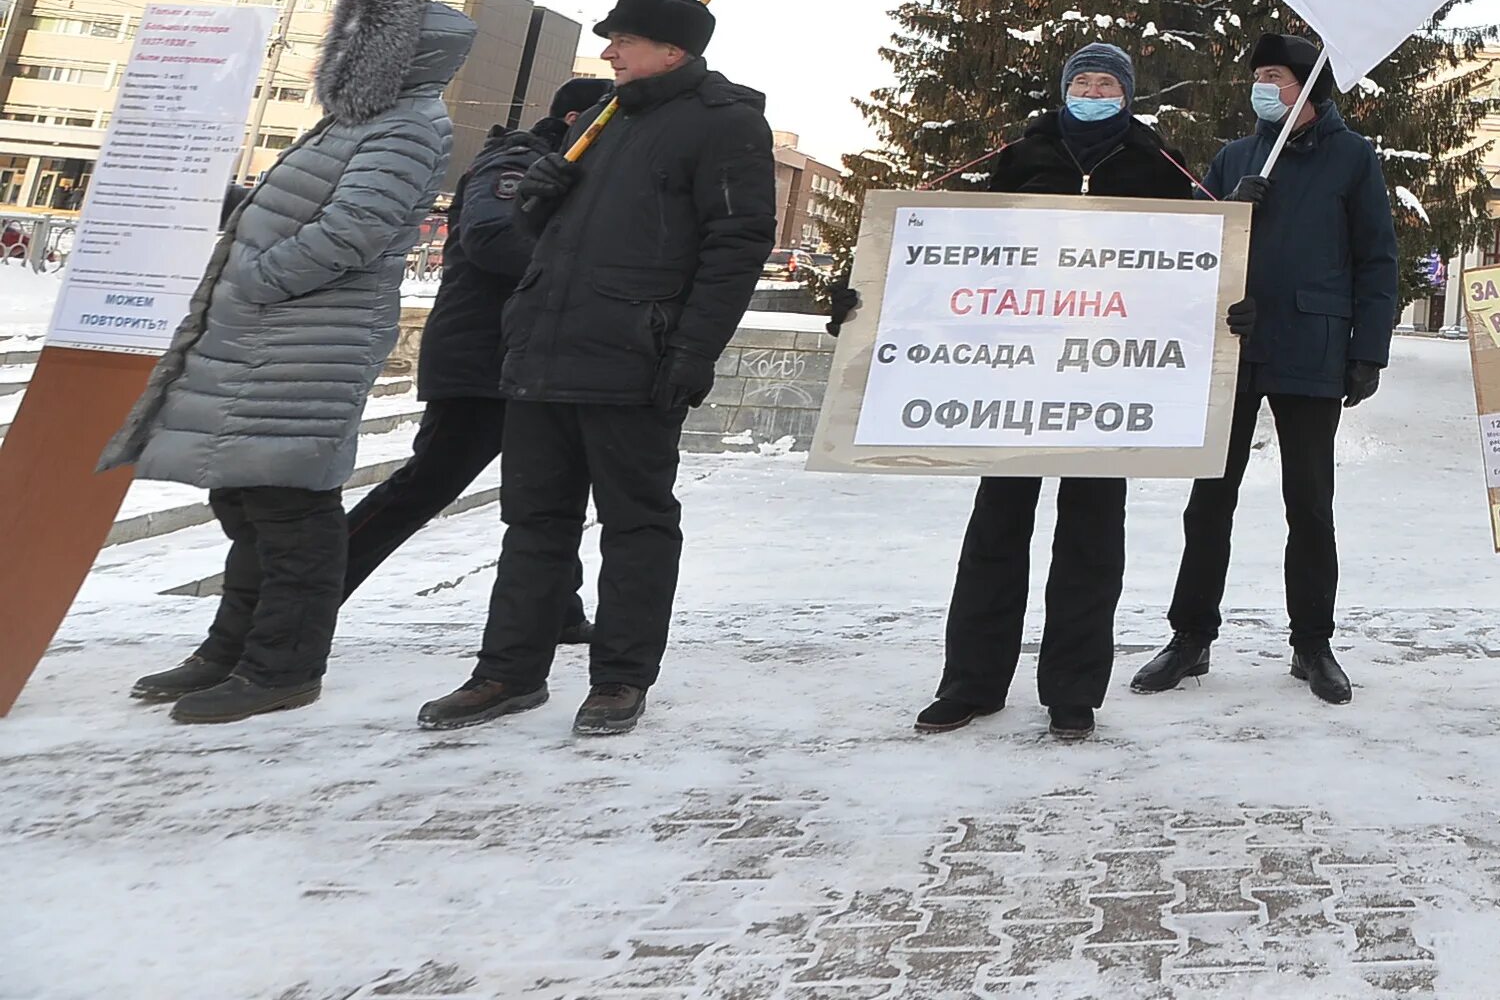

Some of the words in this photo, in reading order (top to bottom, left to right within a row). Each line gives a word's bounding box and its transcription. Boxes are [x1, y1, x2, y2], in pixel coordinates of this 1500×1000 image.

[905, 244, 1039, 267] УБЕРИТЕ
[1057, 247, 1219, 271] БАРЕЛЬЕФ
[105, 293, 154, 307] МОЖЕМ
[950, 287, 1128, 318] СТАЛИНА
[1470, 280, 1499, 302] ЗА
[79, 314, 168, 331] ПОВТОРИТЬ?!
[877, 343, 897, 364] С
[907, 343, 1035, 369] ФАСАДА
[1056, 337, 1186, 373] ДОМА
[902, 398, 1155, 436] ОФИЦЕРОВ
